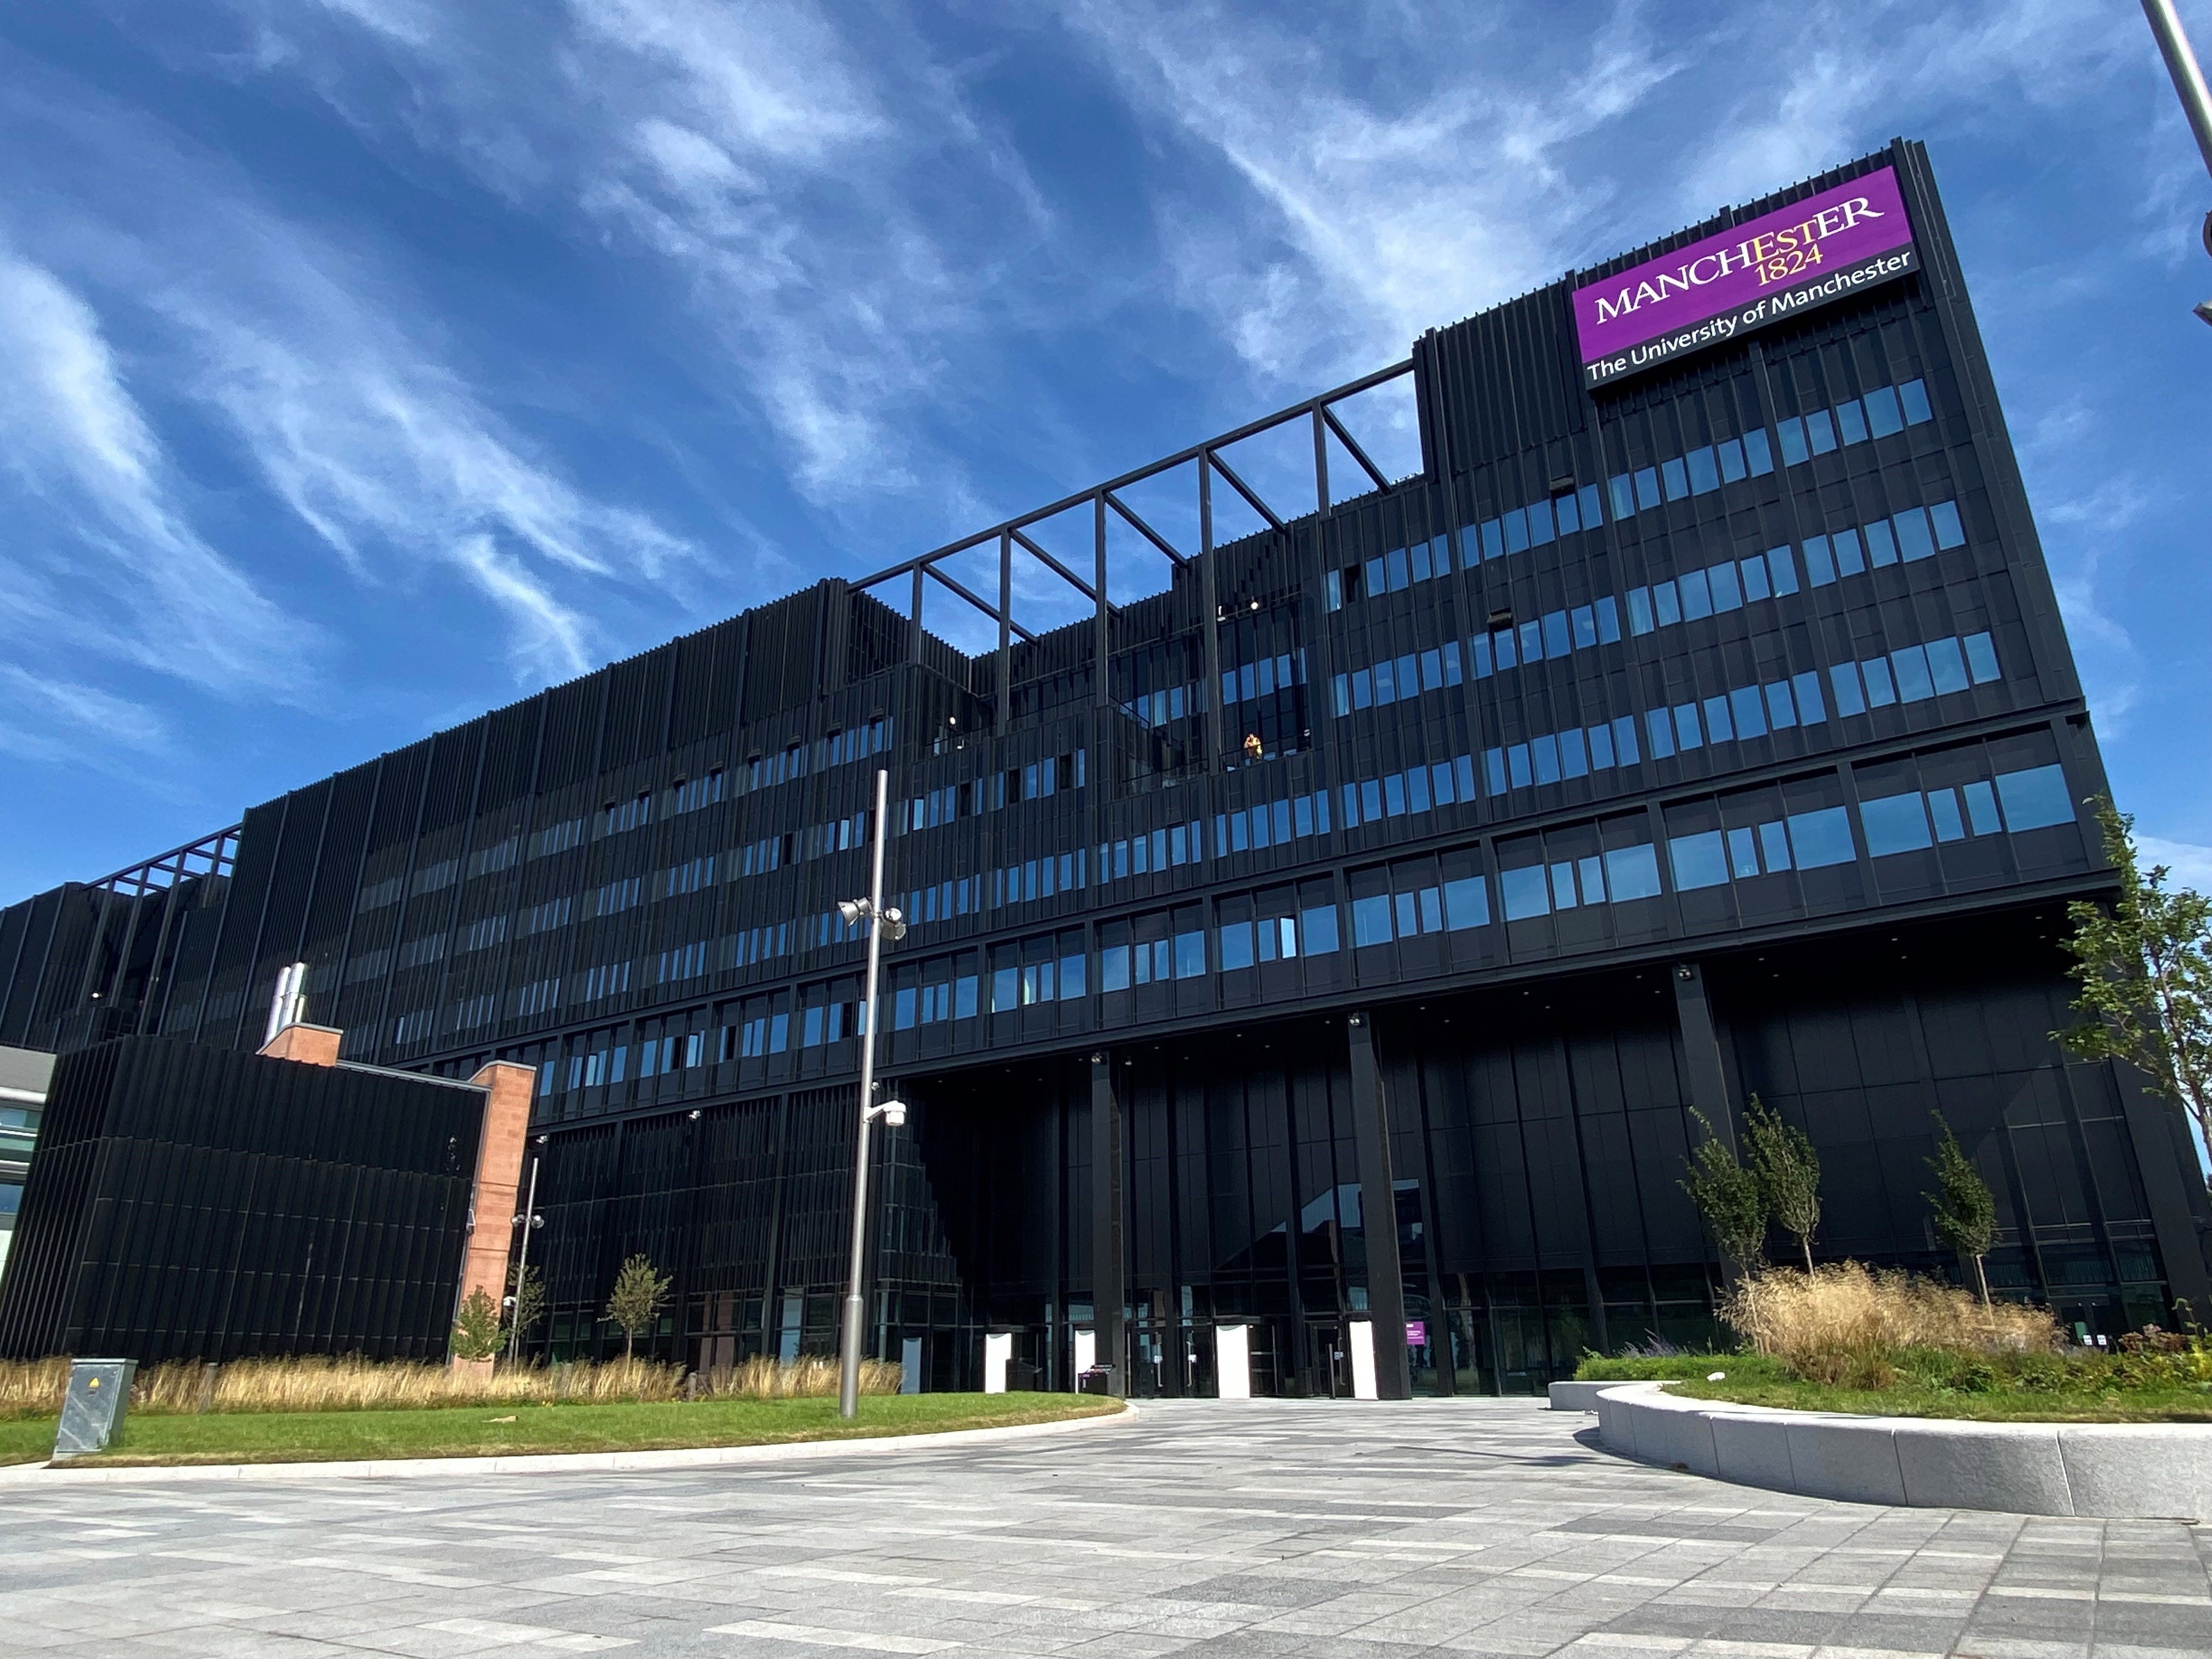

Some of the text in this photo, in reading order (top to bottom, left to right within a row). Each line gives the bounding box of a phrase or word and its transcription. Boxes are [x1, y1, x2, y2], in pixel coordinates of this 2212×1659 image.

[1587, 251, 1910, 380] The University of Manchester
[1595, 196, 1884, 325] MANCHESTER
[1755, 243, 1823, 286] 1824
